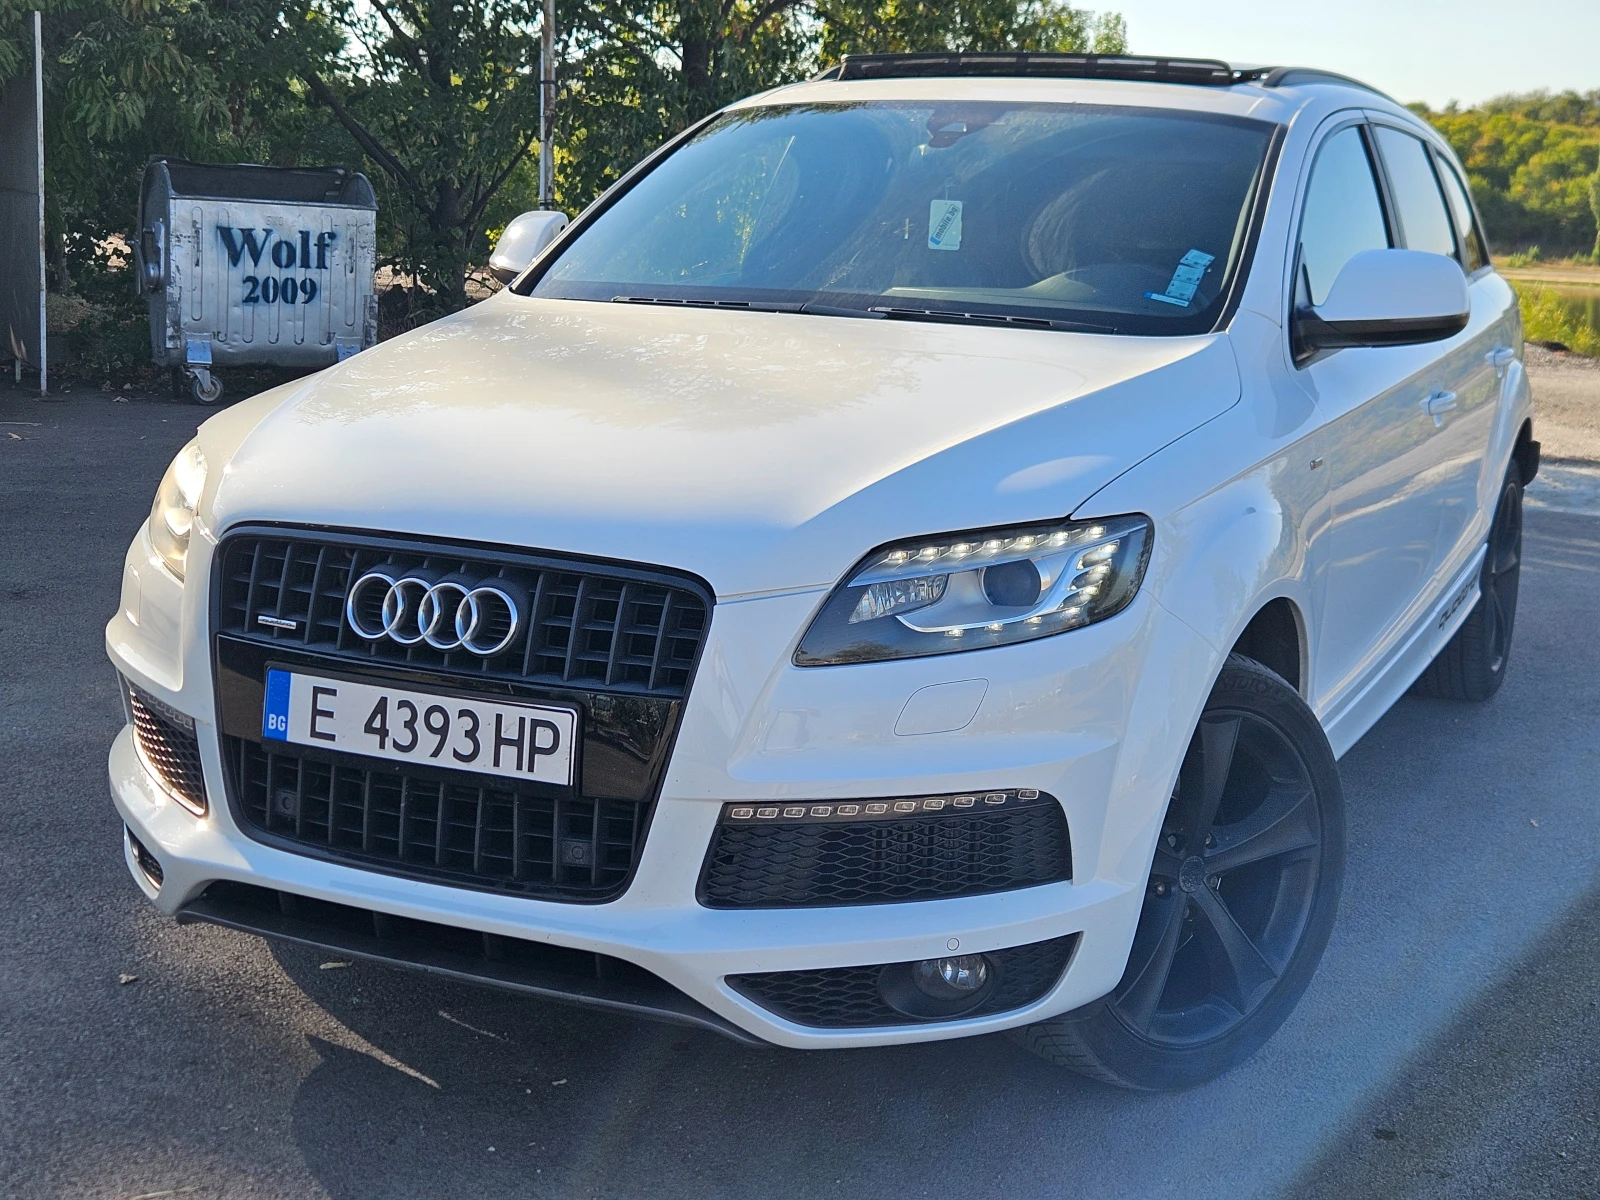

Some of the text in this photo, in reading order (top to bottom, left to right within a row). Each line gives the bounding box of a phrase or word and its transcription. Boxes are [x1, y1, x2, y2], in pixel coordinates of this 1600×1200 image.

[934, 205, 959, 240] mobile.bg
[216, 226, 337, 270] Wolf
[241, 275, 318, 305] 2009
[268, 713, 287, 732] BG
[309, 686, 338, 742] E
